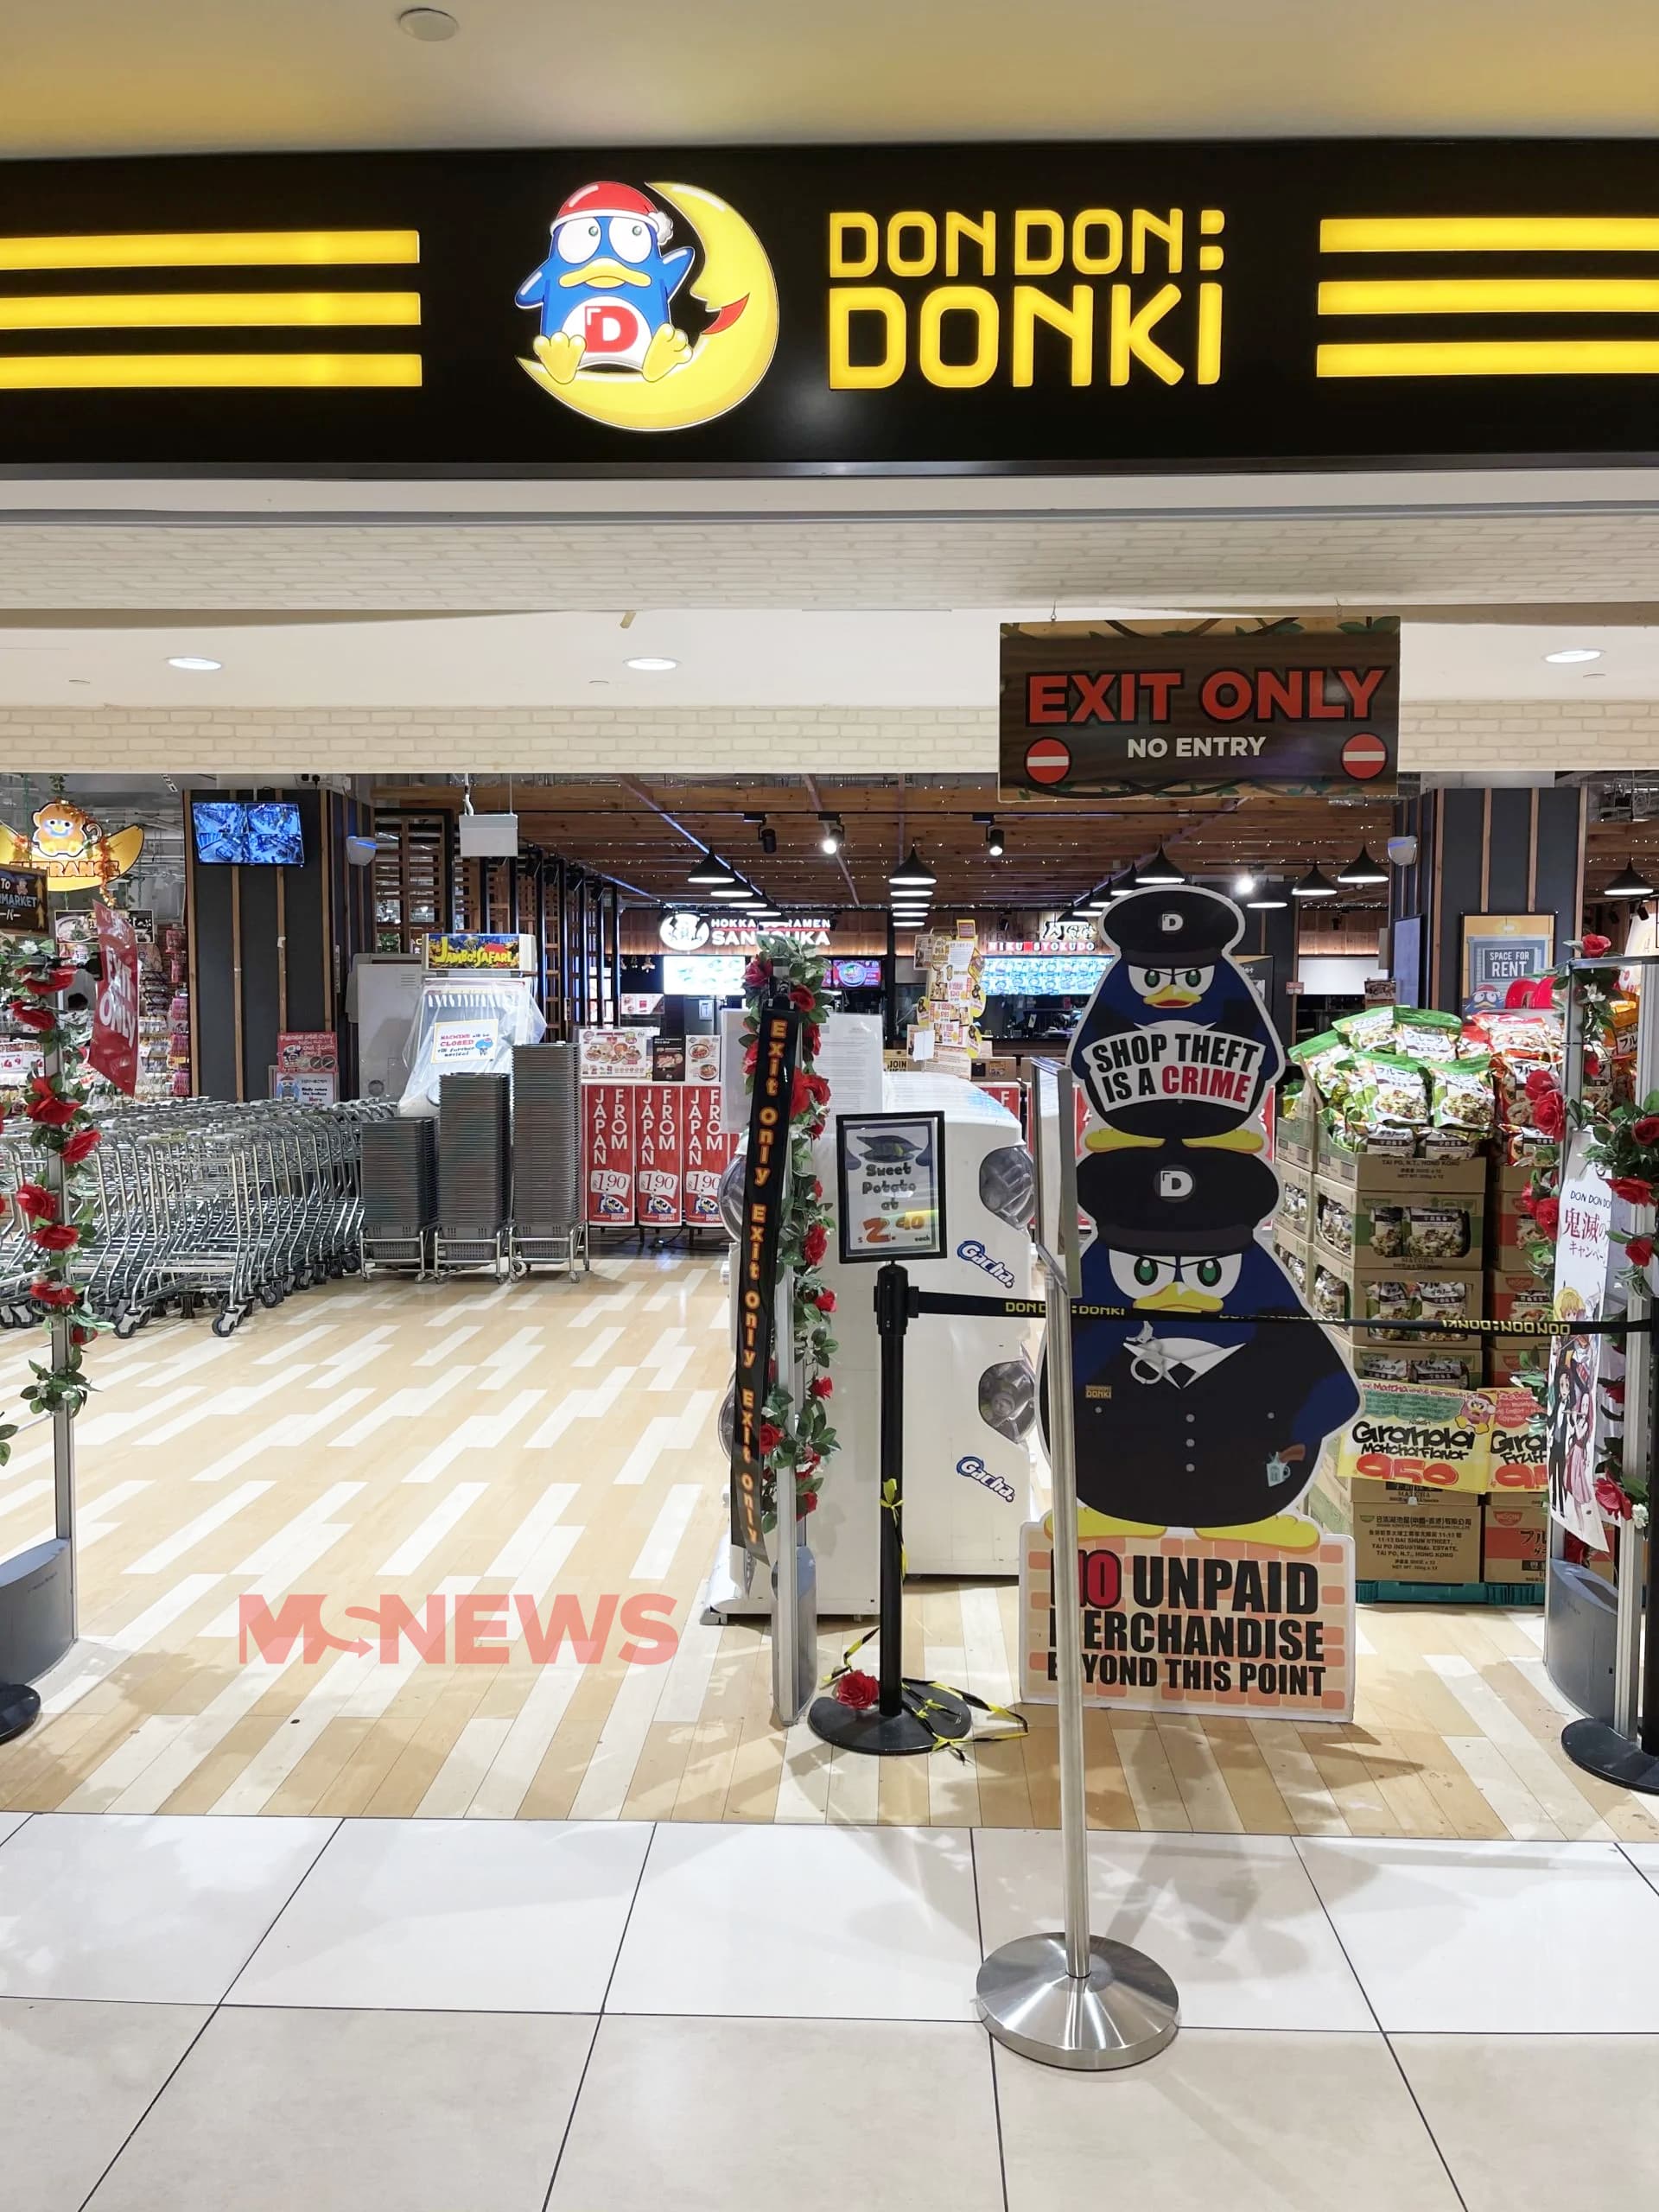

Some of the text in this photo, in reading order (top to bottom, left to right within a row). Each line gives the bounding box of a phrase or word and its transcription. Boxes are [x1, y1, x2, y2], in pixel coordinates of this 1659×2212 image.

[829, 211, 996, 278] DON
[585, 305, 639, 353] D
[827, 283, 1225, 391] DONKI
[1027, 667, 1388, 724] EXIT ONLY
[1127, 736, 1267, 759] NO ENTRY
[1161, 912, 1184, 931] D
[988, 941, 1096, 952] NIKU SYOKUDO
[1490, 951, 1530, 961] SPACE FOR
[1491, 961, 1528, 977] RENT
[99, 991, 137, 1049] ONLY
[766, 1019, 788, 1097] Exit
[1091, 1033, 1261, 1073] SHOP THEFT
[1102, 1065, 1252, 1104] IS A CRIME
[593, 1088, 607, 1165] JAPAN
[611, 1089, 628, 1150] FROM
[640, 1089, 655, 1166] JAPAN
[658, 1089, 676, 1151] FROM
[688, 1089, 703, 1166] JAPAN
[706, 1089, 723, 1151] FROM
[861, 1179, 917, 1195] Potato
[865, 1162, 912, 1178] Sweet
[1159, 1171, 1194, 1198] D
[880, 1197, 899, 1211] at
[1570, 1191, 1587, 1202] DON
[1588, 1194, 1603, 1206] DON
[748, 1202, 767, 1281] Exit
[1562, 1207, 1608, 1244] 鬼滅の
[1005, 1300, 1037, 1313] DON
[1133, 1554, 1319, 1616] UNPAID
[1165, 1658, 1232, 1693] THIS
[1239, 1662, 1326, 1697] POINT
